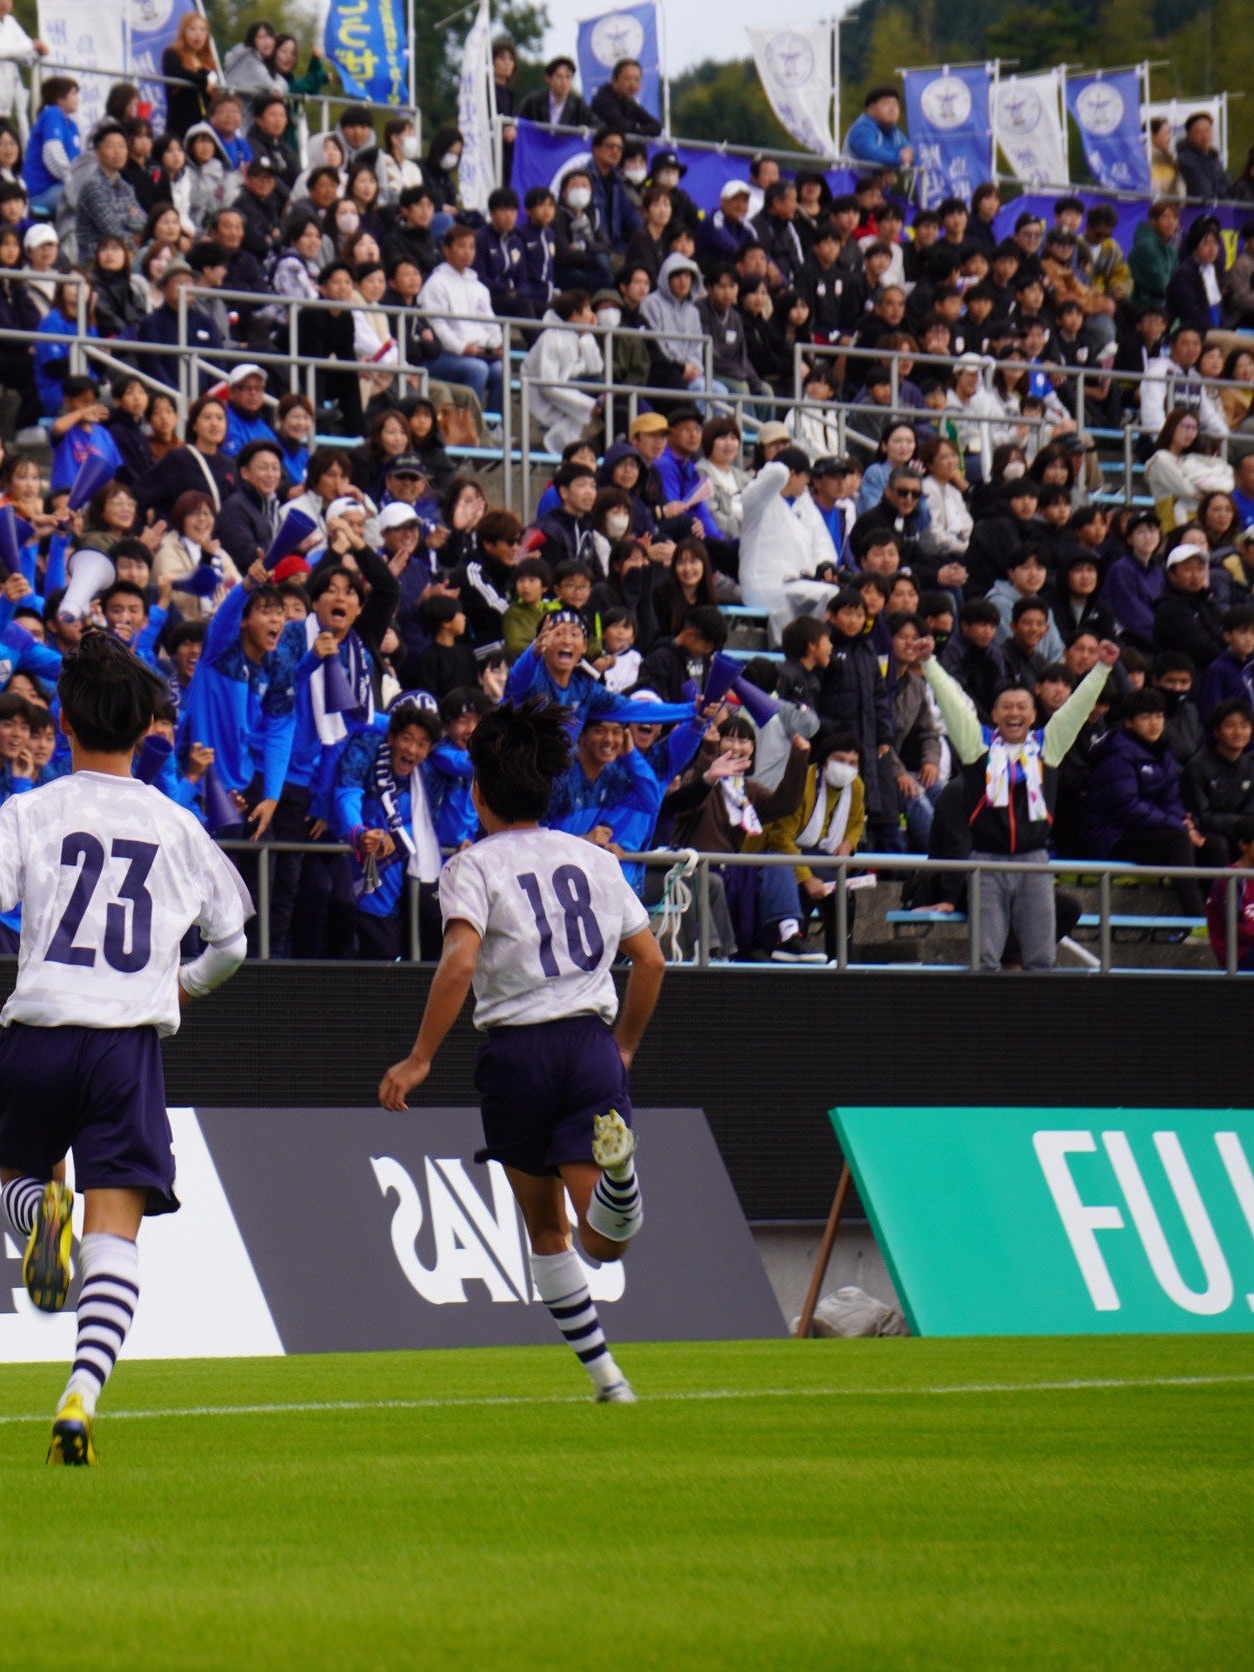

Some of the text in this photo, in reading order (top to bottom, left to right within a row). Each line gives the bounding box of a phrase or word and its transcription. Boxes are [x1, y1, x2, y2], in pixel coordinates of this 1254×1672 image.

[45, 832, 159, 973] 23
[517, 864, 604, 977] 18
[370, 1155, 626, 1305] SAV
